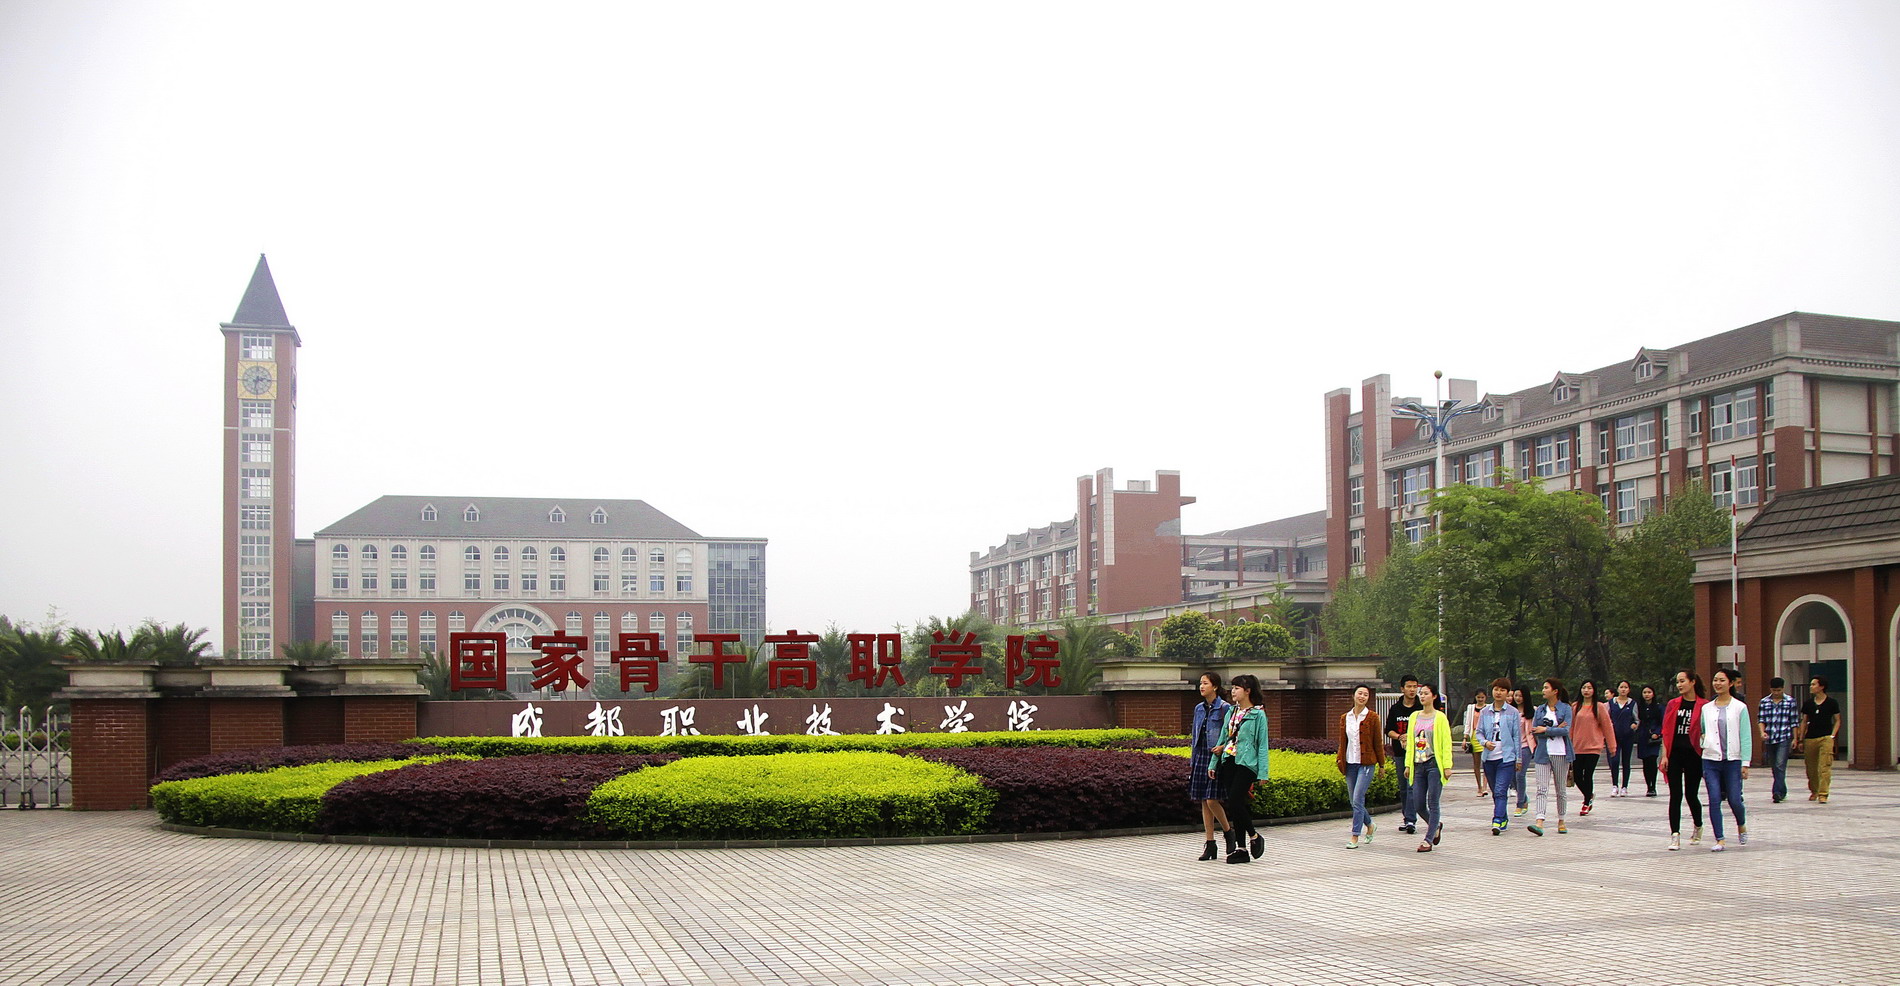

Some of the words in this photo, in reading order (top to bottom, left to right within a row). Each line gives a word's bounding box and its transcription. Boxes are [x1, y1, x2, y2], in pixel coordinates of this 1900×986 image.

[450, 628, 1062, 693] 国家骨干高职学院
[511, 700, 1042, 737] 成都职业技术学院
[1677, 709, 1692, 717] WH
